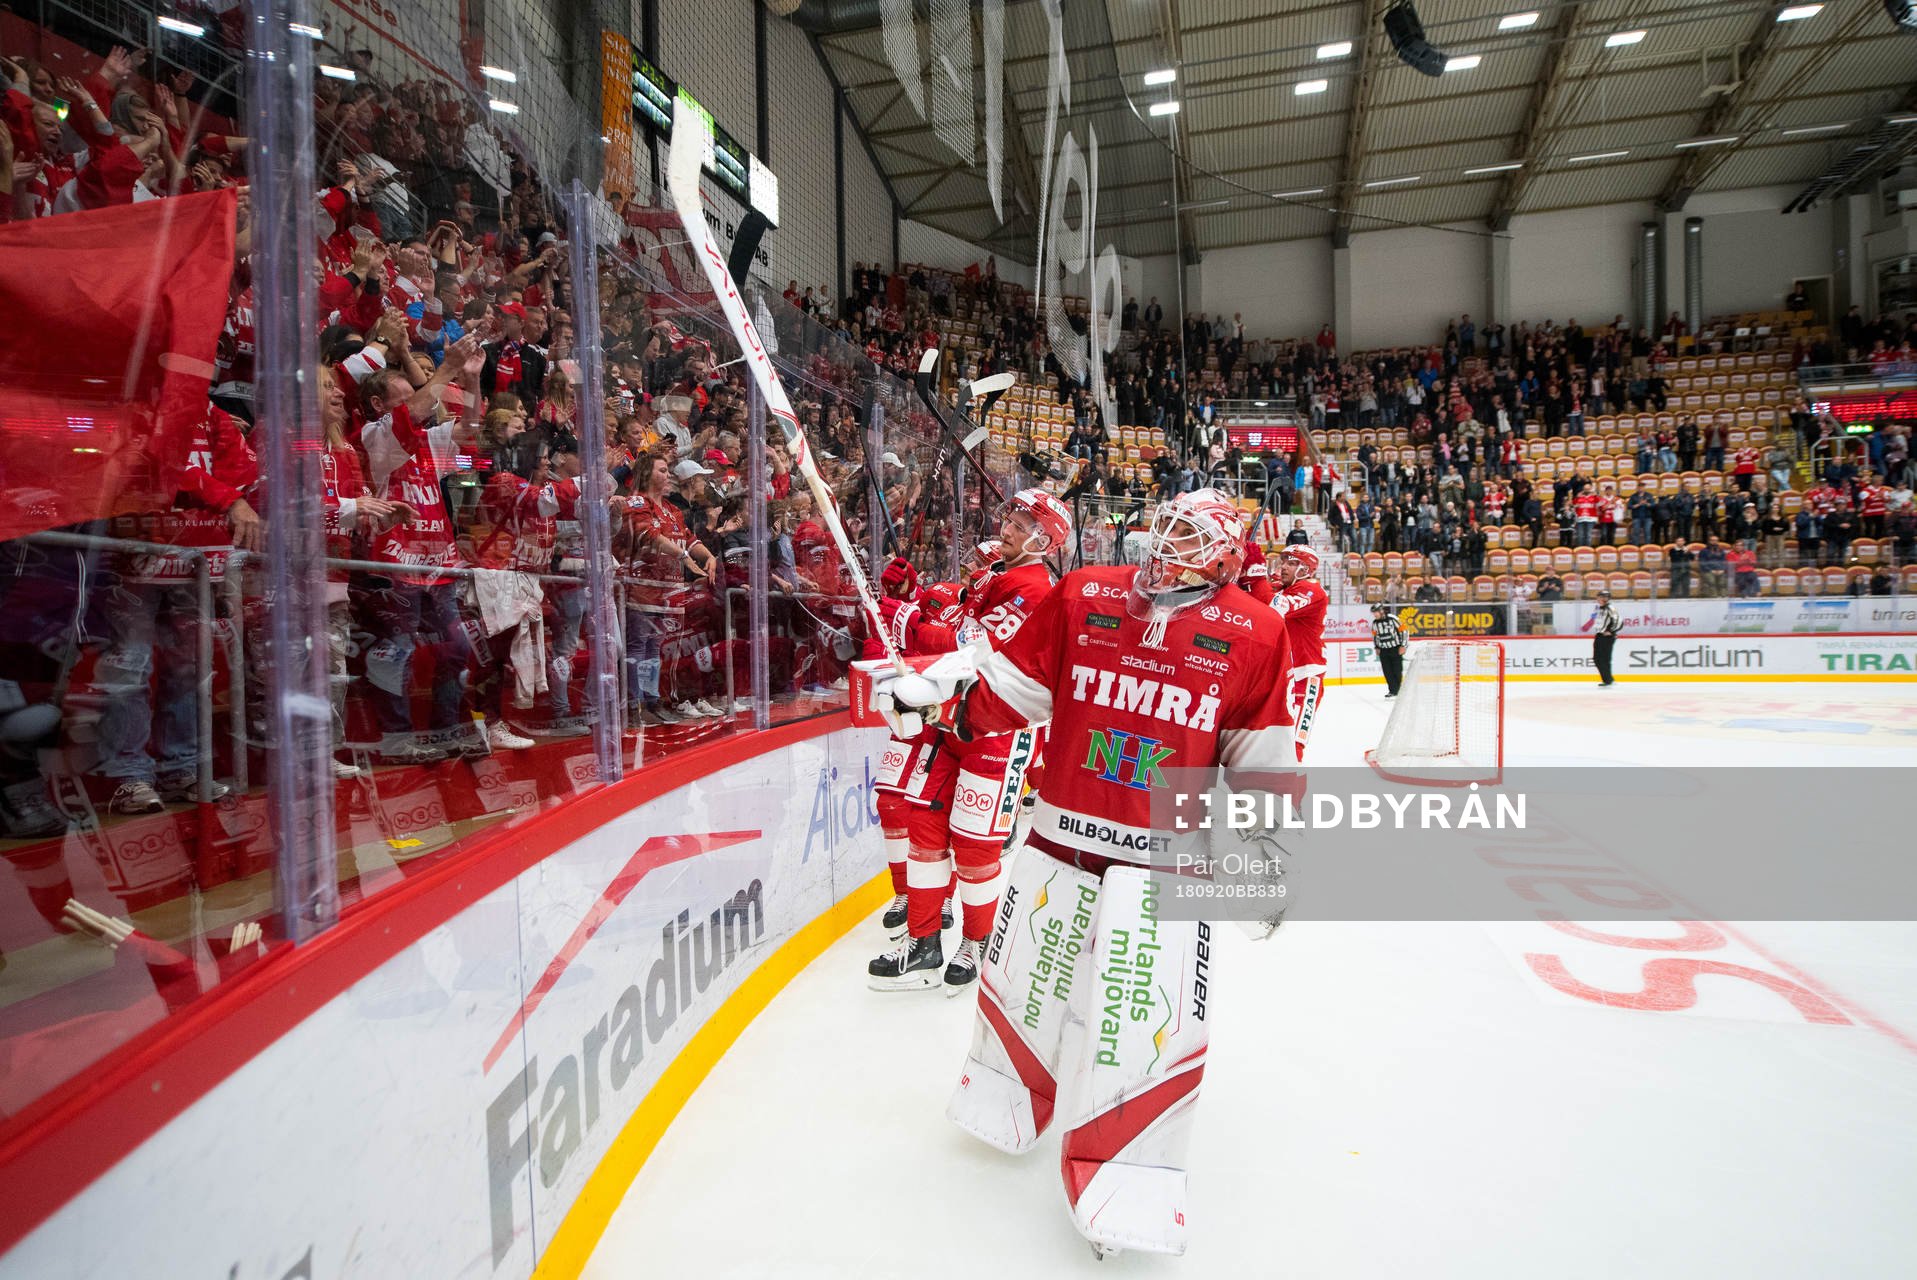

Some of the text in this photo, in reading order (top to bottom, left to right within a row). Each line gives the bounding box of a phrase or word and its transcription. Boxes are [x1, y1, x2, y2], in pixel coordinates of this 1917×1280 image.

[1101, 586, 1129, 600] SCA
[891, 603, 911, 648] AUER
[979, 605, 1021, 641] 28
[1223, 611, 1253, 630] SCA
[1089, 638, 1118, 648] CASTELLUM
[1184, 653, 1230, 672] JOWIC
[1504, 657, 1596, 668] ELLEXTRE
[1629, 645, 1763, 669] stadium
[1819, 653, 1917, 671] TIRA
[1120, 655, 1176, 676] stadium
[856, 678, 864, 719] SUPREME
[1071, 664, 1222, 733] TIMRÅ
[1300, 683, 1318, 732] PEAB
[1000, 731, 1032, 815] PEAB
[1058, 814, 1172, 853] BILBOLAGET
[989, 885, 1020, 966] BAUER
[1130, 880, 1162, 1022] norrlands
[1192, 920, 1210, 1021] BAUER
[1023, 917, 1064, 1029] norrlands
[485, 878, 765, 1272] Faradium
